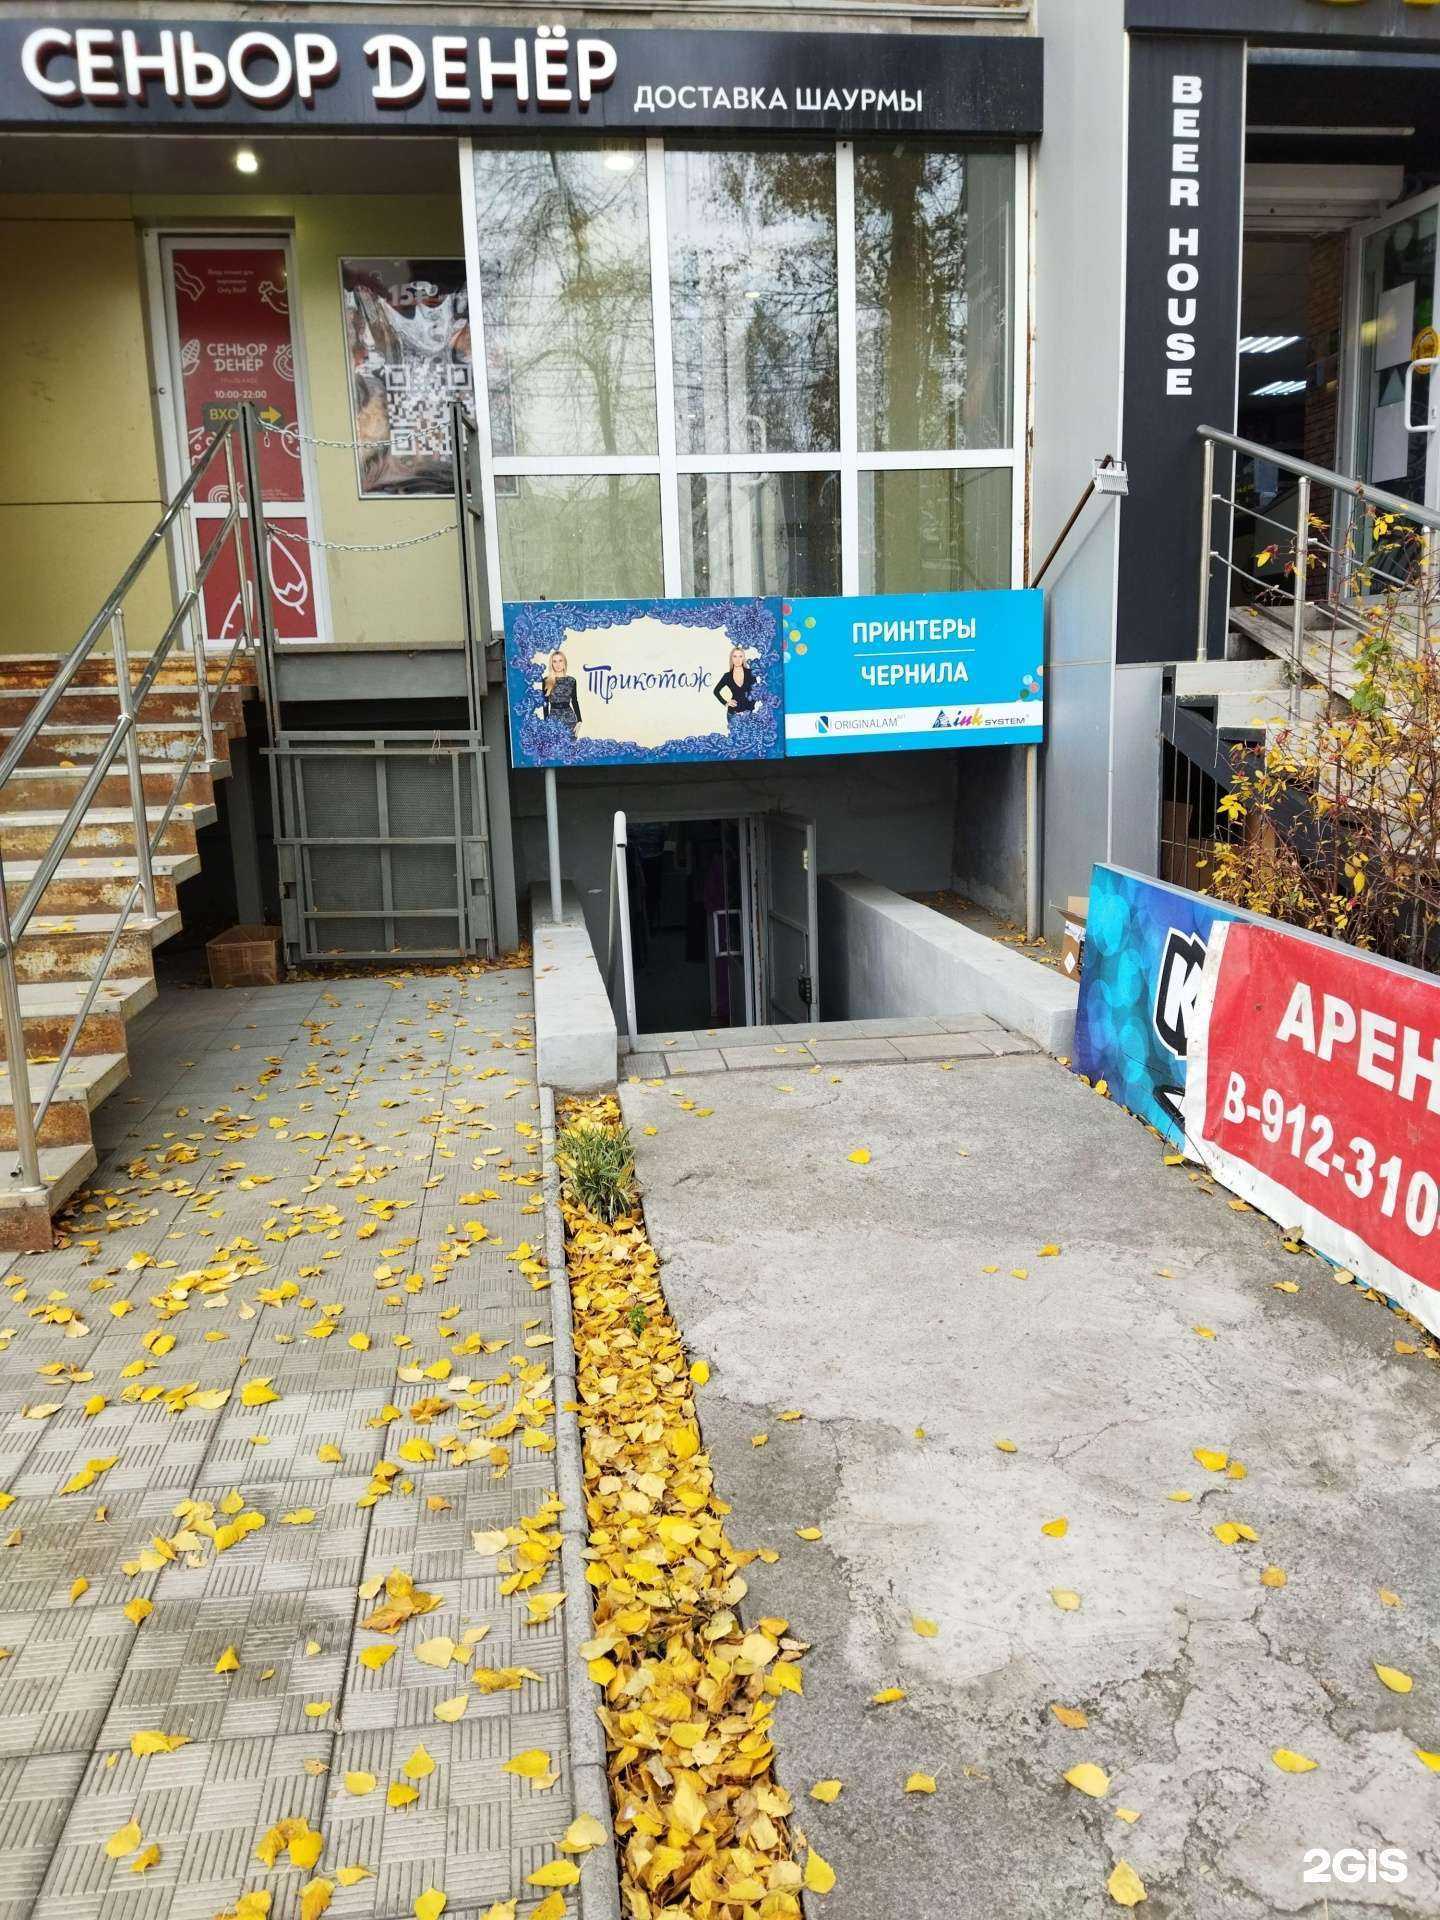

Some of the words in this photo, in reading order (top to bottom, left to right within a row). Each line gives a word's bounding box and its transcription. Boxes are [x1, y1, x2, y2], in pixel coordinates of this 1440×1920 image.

[21, 27, 339, 101] СЕНЬОР
[633, 85, 788, 113] ДОСТАВКА
[795, 87, 924, 113] ШАУРМЫ
[1169, 74, 1203, 207] BEER
[1166, 227, 1199, 396] HOUSE
[206, 343, 268, 357] СЕНЬОР
[214, 390, 268, 399] 10:00-22:00
[209, 408, 240, 420] ВХО
[852, 617, 976, 643] ПРИНТЕРЫ
[583, 663, 712, 704] Трикотаж
[861, 661, 969, 686] ЧЕРНИЛА
[1275, 981, 1440, 1117] АРЕН
[1223, 1071, 1440, 1238] 8-912-310
